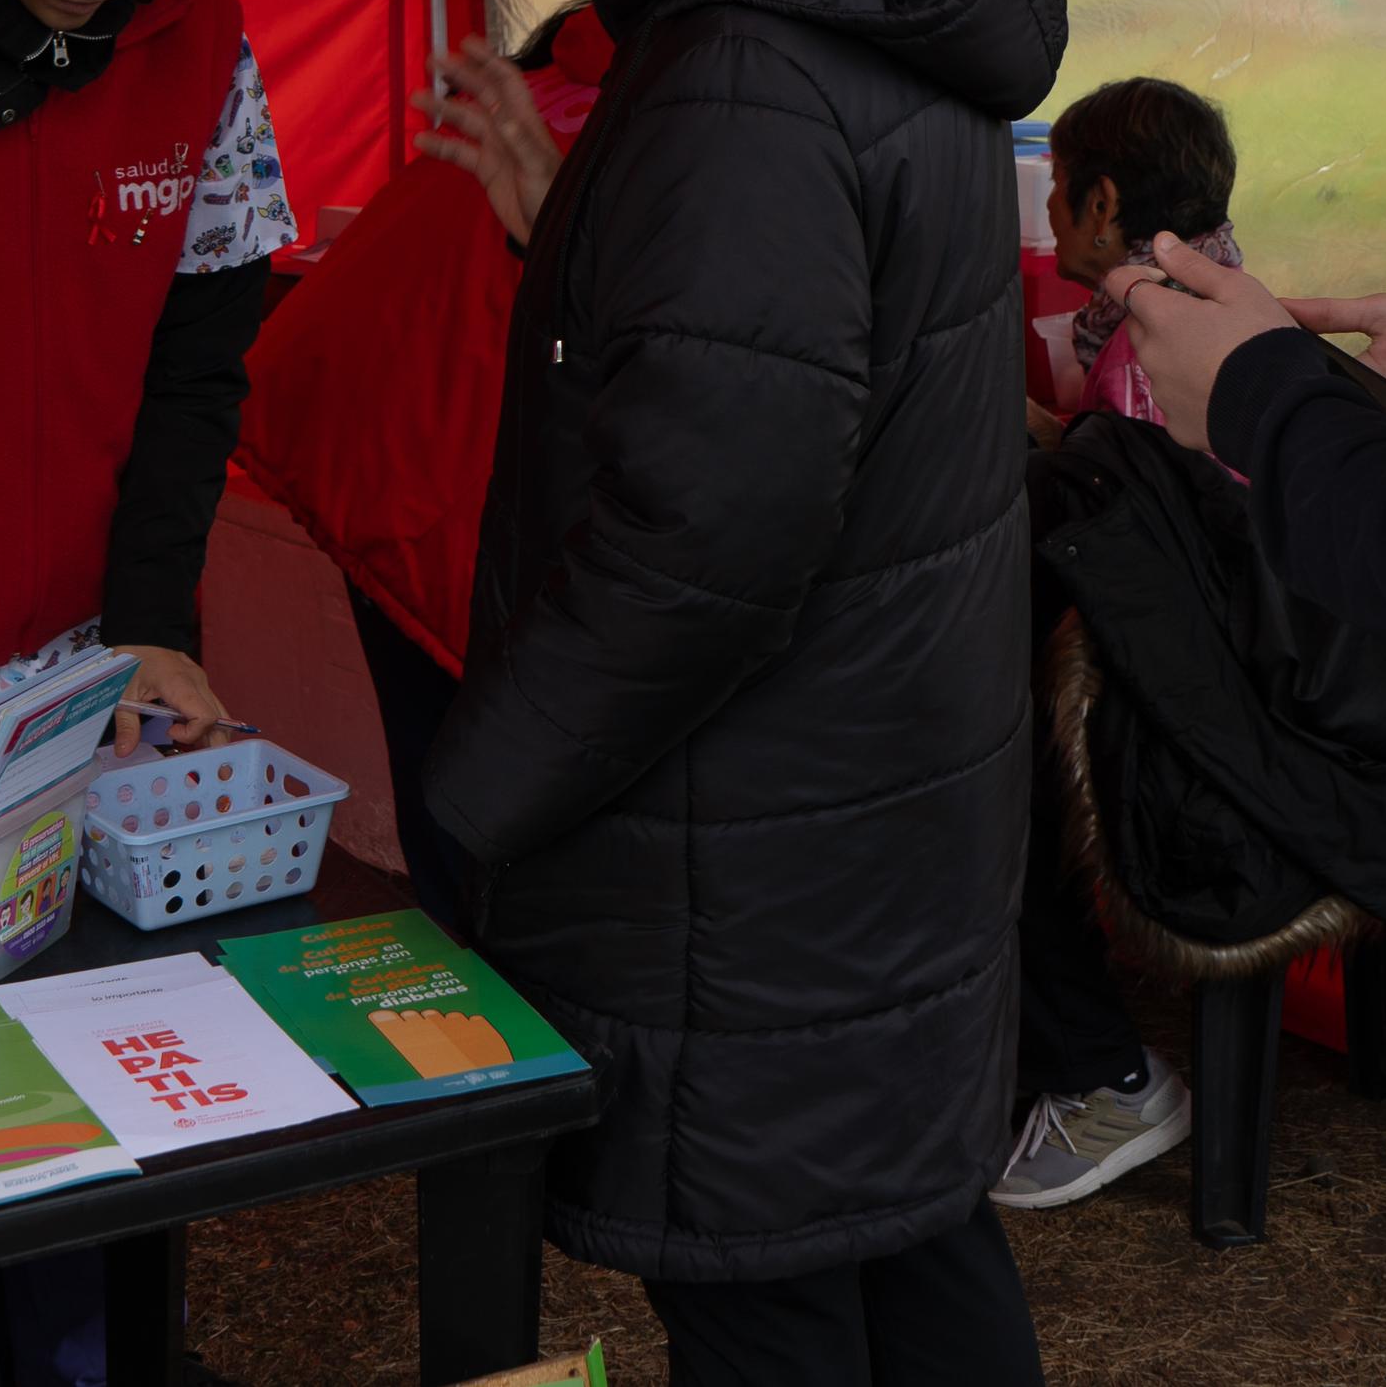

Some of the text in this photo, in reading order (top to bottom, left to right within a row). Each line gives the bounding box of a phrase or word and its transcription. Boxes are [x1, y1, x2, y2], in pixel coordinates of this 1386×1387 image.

[115, 158, 169, 180] salud
[118, 173, 196, 217] mgp
[301, 920, 394, 944] Cuidados
[278, 941, 405, 974] de los pies en
[303, 934, 398, 960] Cuidados
[304, 948, 411, 980] personas con
[350, 962, 447, 987] Cuidados
[104, 988, 164, 1002] importante
[325, 969, 454, 1002] de los pies en
[350, 976, 461, 1007] personas con
[378, 984, 470, 1010] diabetes
[100, 1028, 186, 1057] HE
[117, 1049, 205, 1075] PA
[133, 1069, 198, 1093] TI
[149, 1082, 250, 1112] TIS
